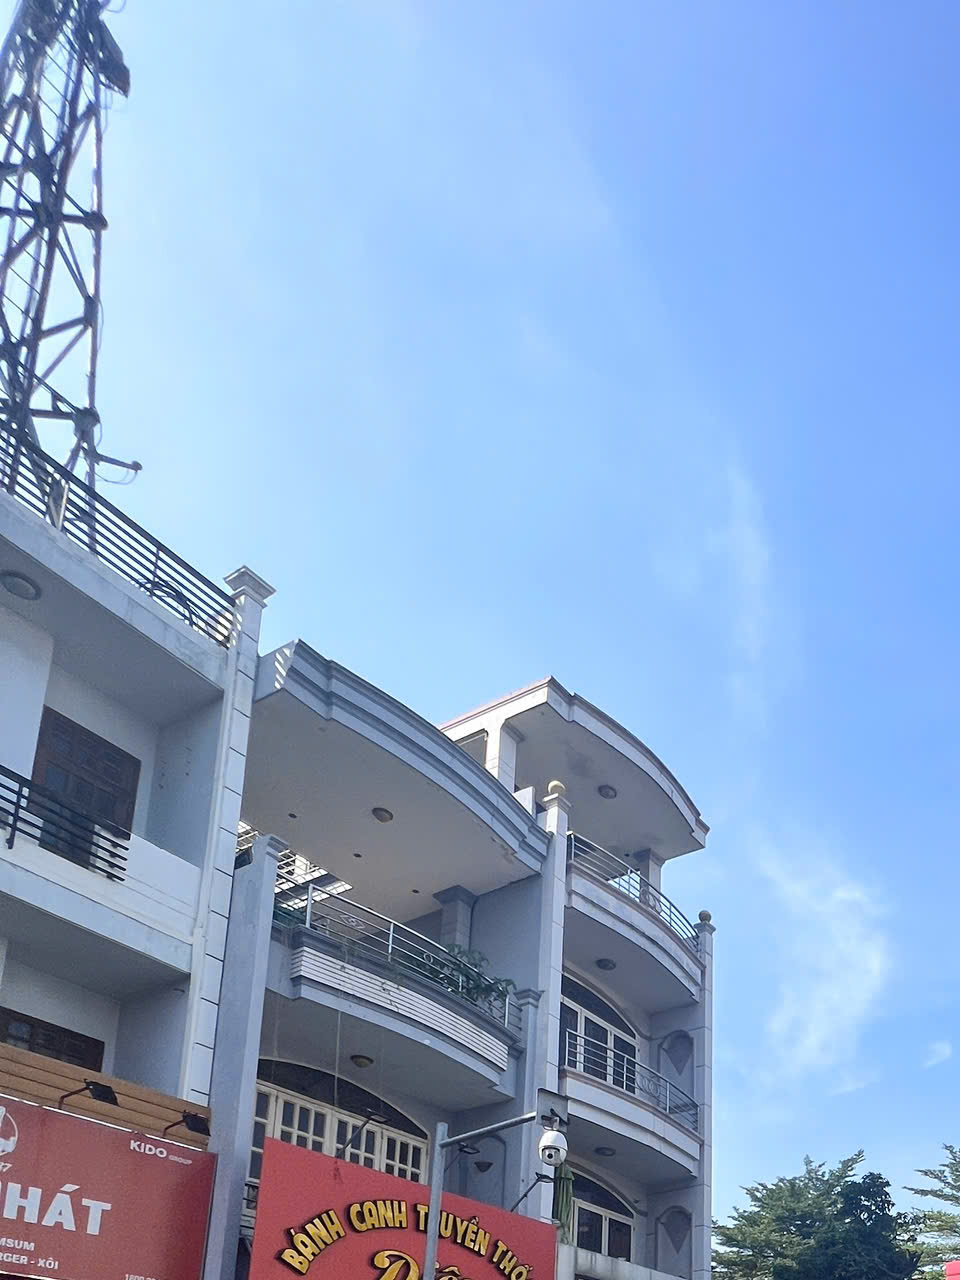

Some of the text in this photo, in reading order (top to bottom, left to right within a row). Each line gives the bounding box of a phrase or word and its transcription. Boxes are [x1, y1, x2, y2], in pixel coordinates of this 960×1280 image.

[130, 1139, 168, 1158] KIDO
[0, 1182, 112, 1235] HÁT
[277, 1208, 347, 1275] BÁNH
[349, 1199, 408, 1232] CANH
[415, 1203, 492, 1256] TUYỀN
[37, 1256, 59, 1270] XÔI
